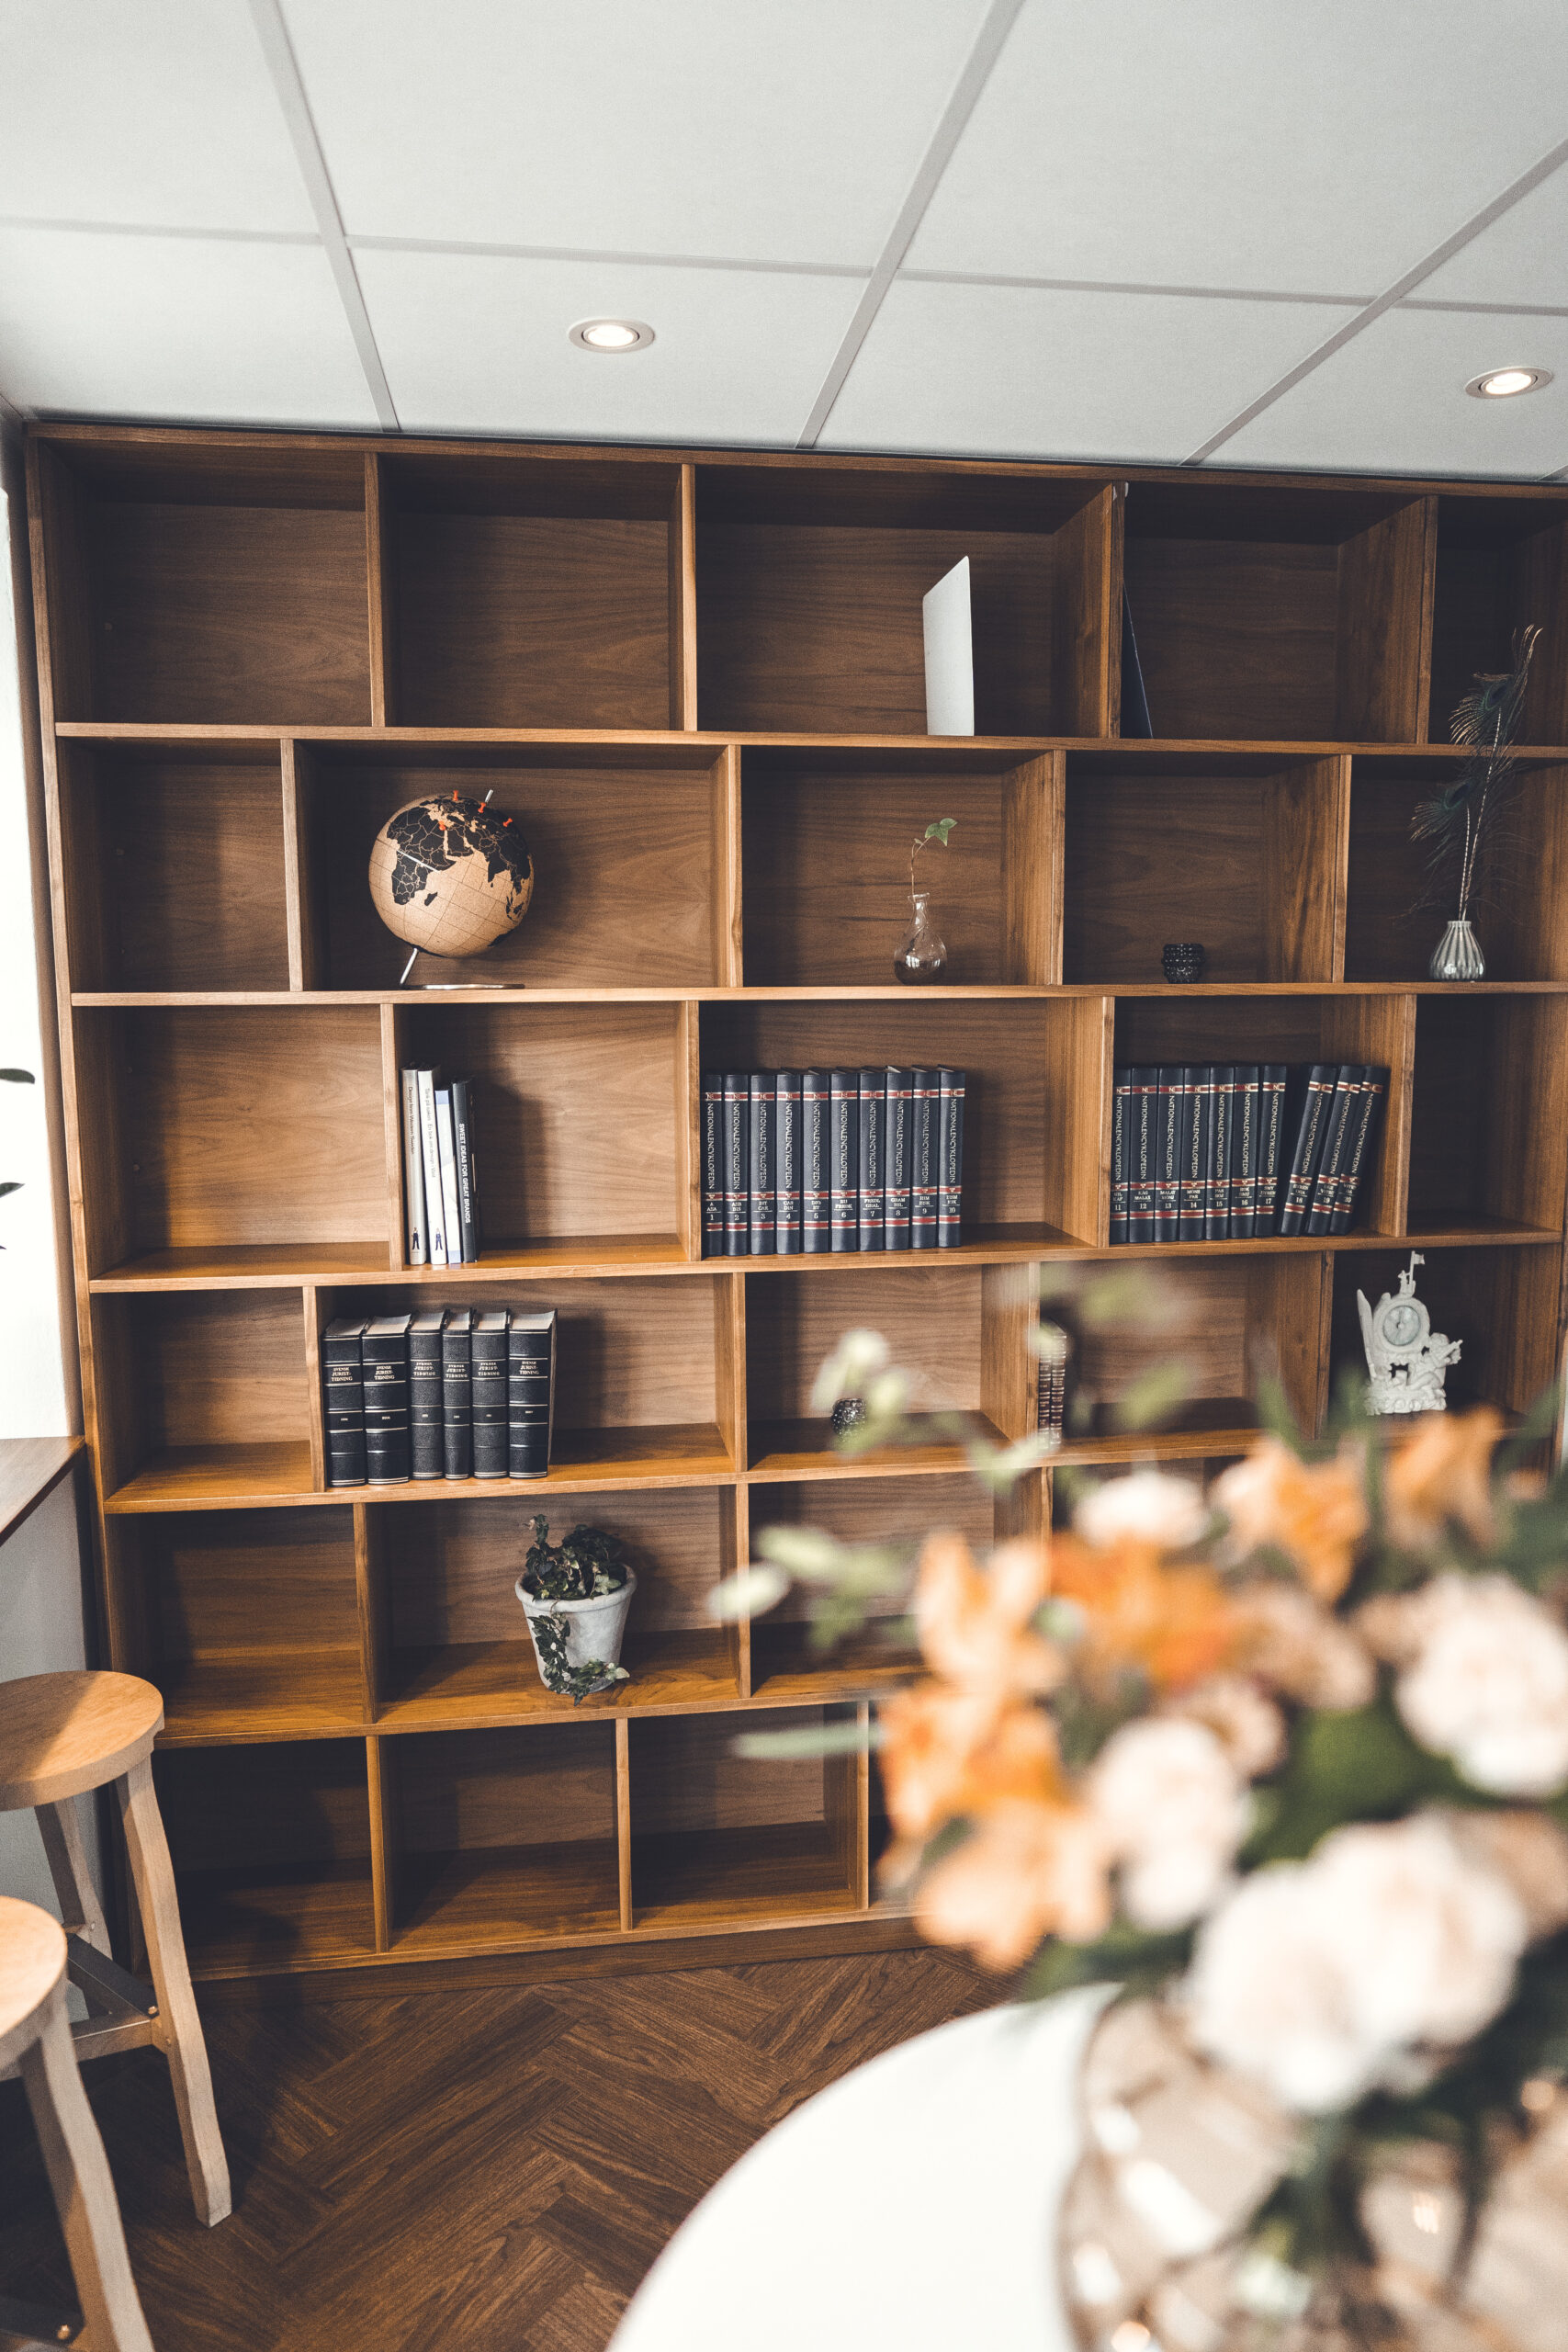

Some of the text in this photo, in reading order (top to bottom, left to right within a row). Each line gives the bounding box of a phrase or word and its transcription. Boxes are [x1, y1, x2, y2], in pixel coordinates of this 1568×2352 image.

[896, 1100, 904, 1185] NATIONALENCYKLOPEDIN
[1192, 1095, 1201, 1179] NATIONALENCYKLOPEDIN
[1216, 1094, 1224, 1178] NATIONALENCYKLOPEDIN
[1268, 1093, 1279, 1175] NATIONALENCYKLOPEDIN
[1302, 1093, 1324, 1174] NATIONALENCYKLOPEDIN
[1330, 1093, 1351, 1174] NATIONALENCYKLOPEDIN
[1352, 1092, 1374, 1173] NATIONALENCYKLOPEDIN
